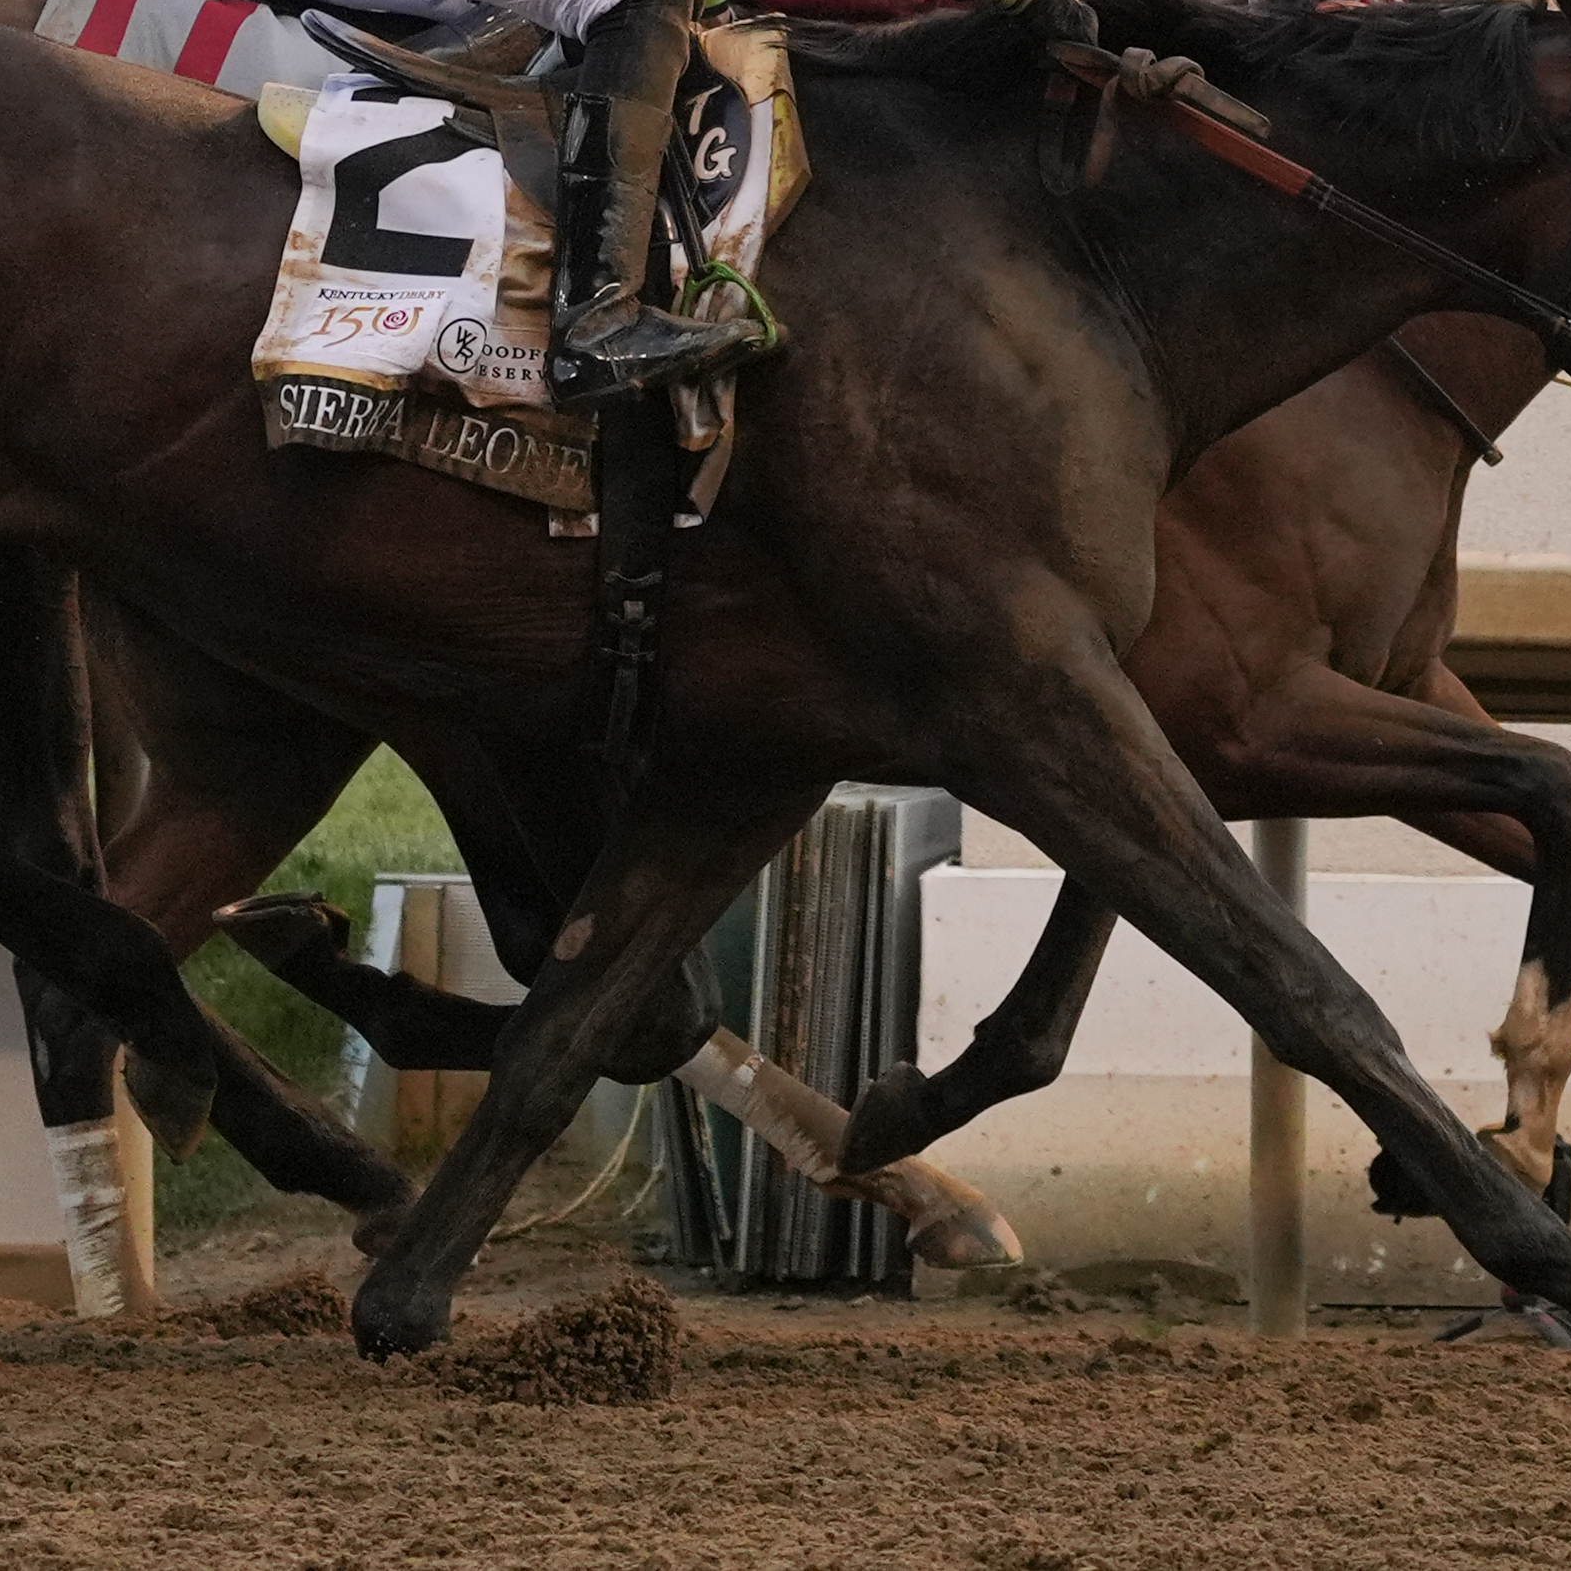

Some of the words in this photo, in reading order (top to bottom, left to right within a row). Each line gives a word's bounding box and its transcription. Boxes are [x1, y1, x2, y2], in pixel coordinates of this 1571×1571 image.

[319, 85, 492, 278] 2
[317, 288, 397, 301] KENTUCKY
[398, 290, 447, 301] DERBY
[482, 344, 547, 361] OODF
[280, 383, 404, 441] SIERRA
[421, 407, 588, 478] LEONE
